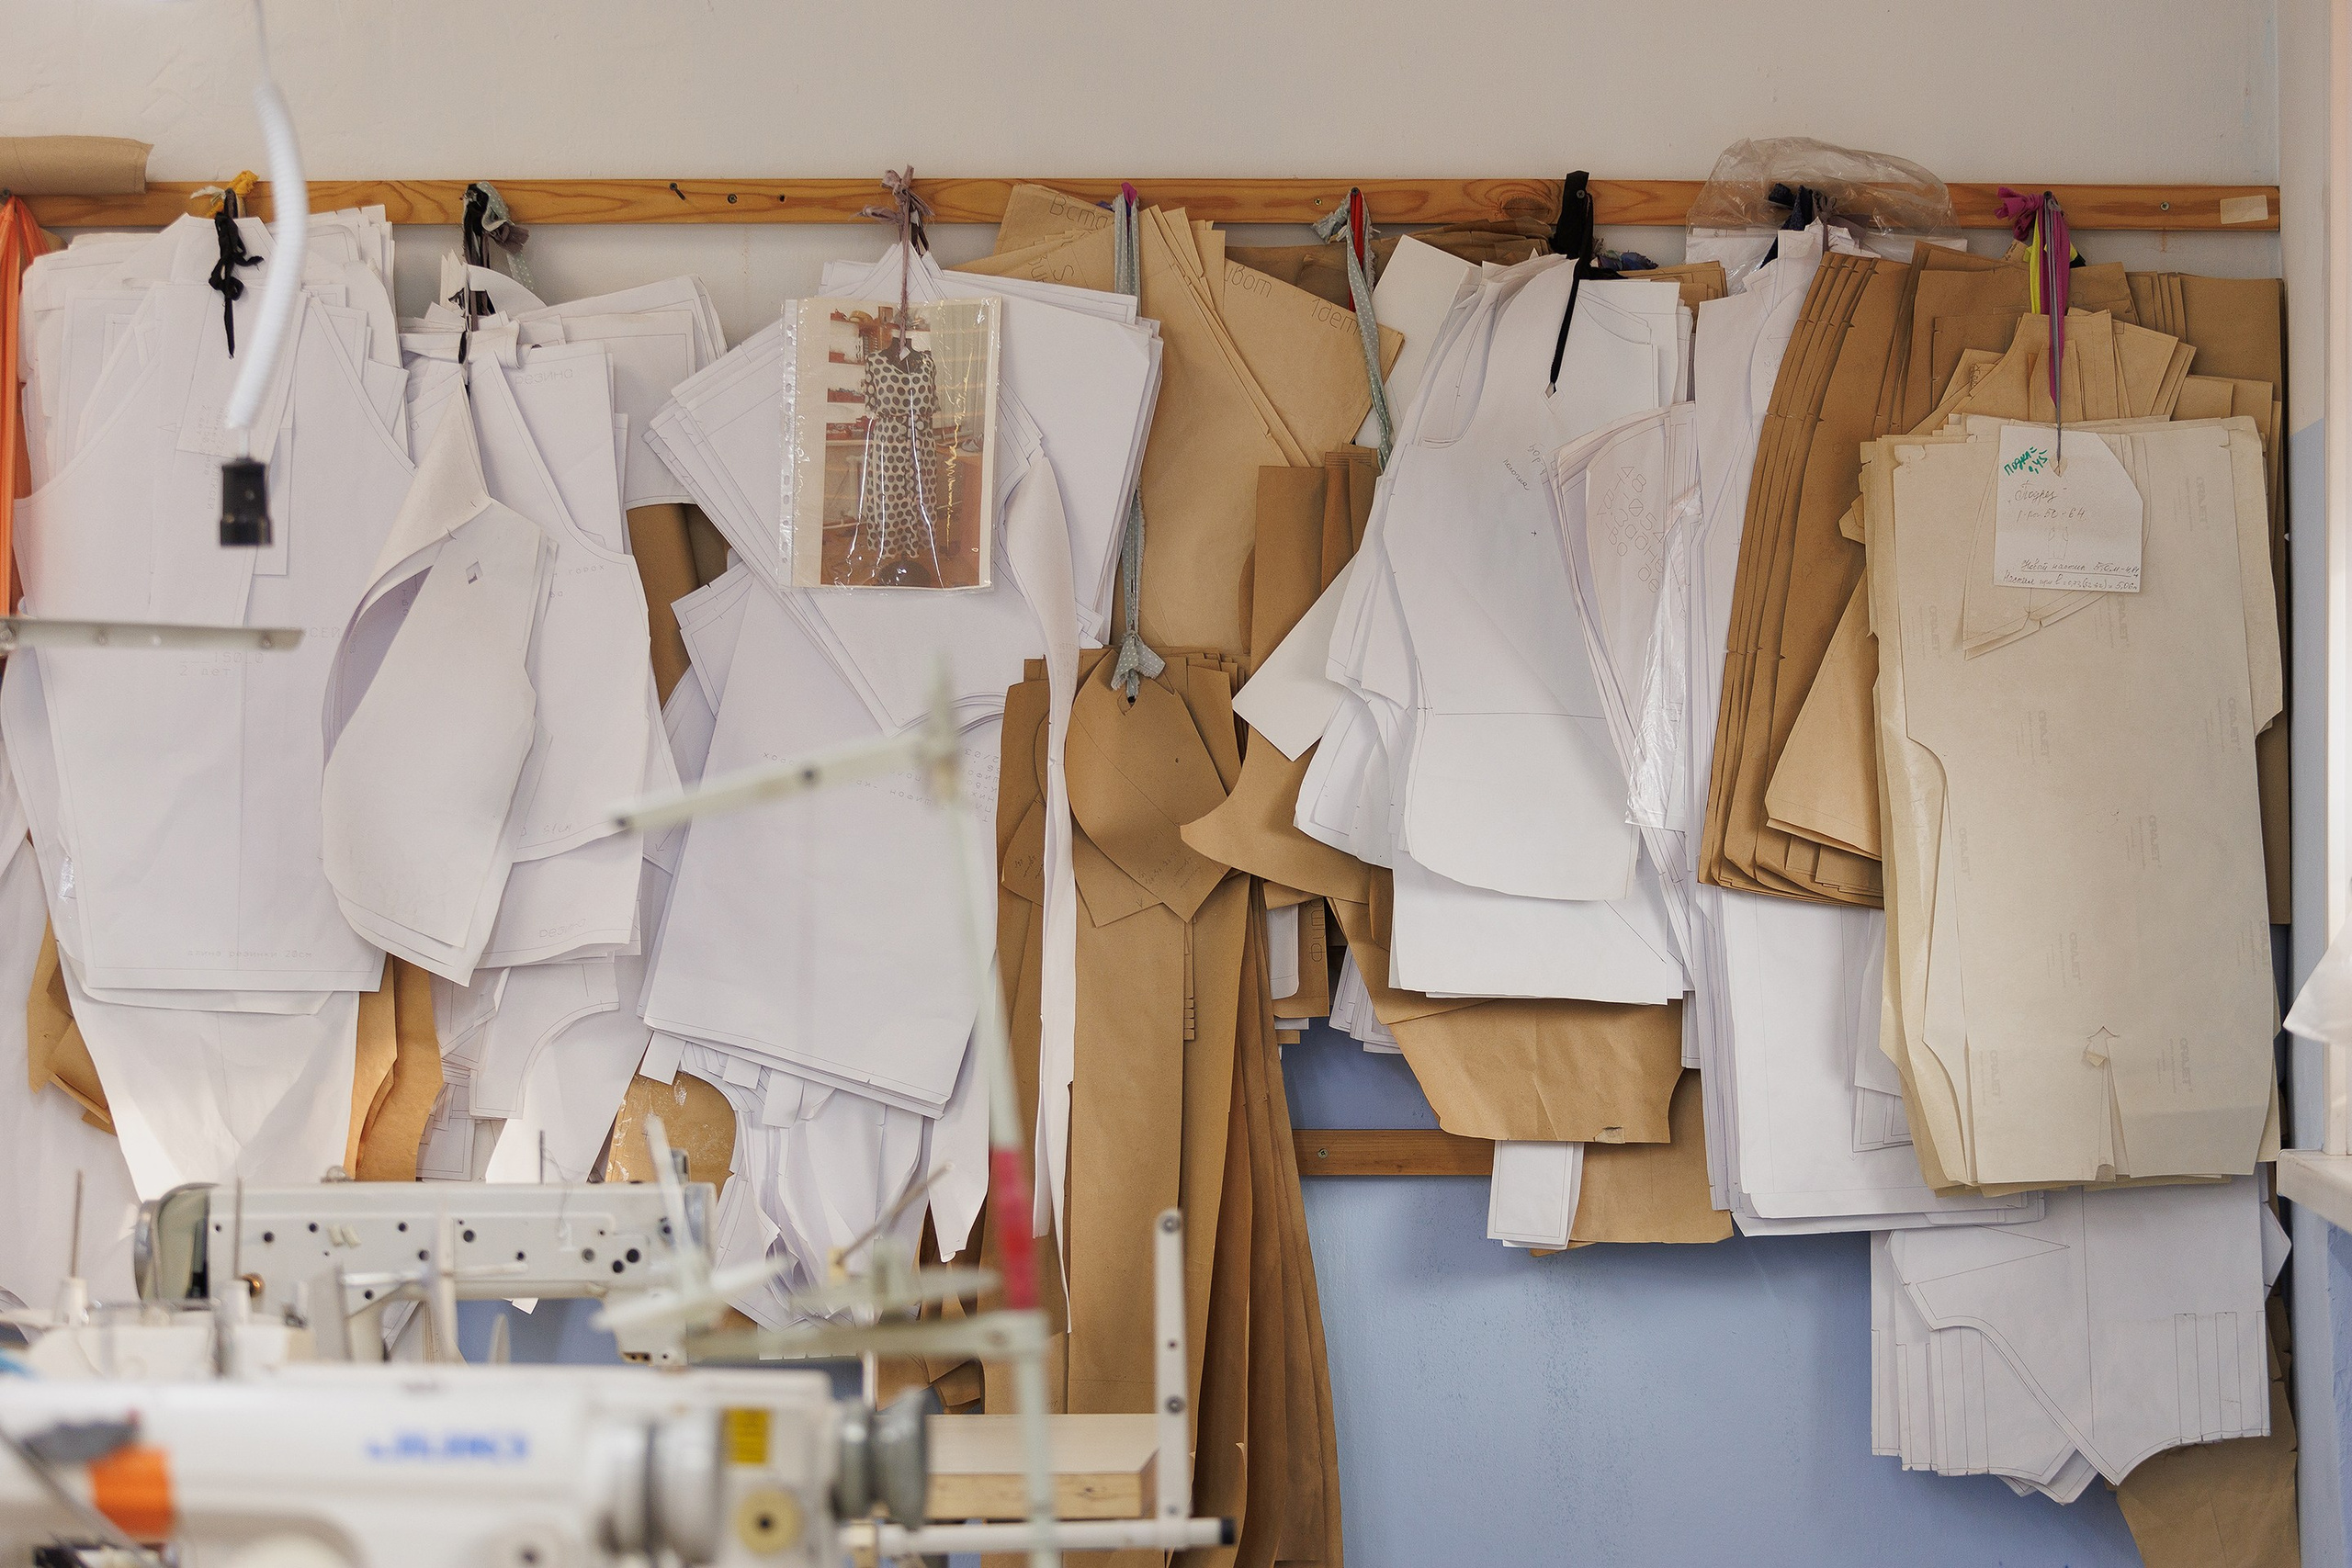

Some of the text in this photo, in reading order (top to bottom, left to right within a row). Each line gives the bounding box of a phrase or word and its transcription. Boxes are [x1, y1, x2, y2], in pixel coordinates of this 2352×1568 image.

[514, 368, 573, 385] резина
[1621, 466, 1647, 493] 48
[228, 950, 277, 959] резинки
